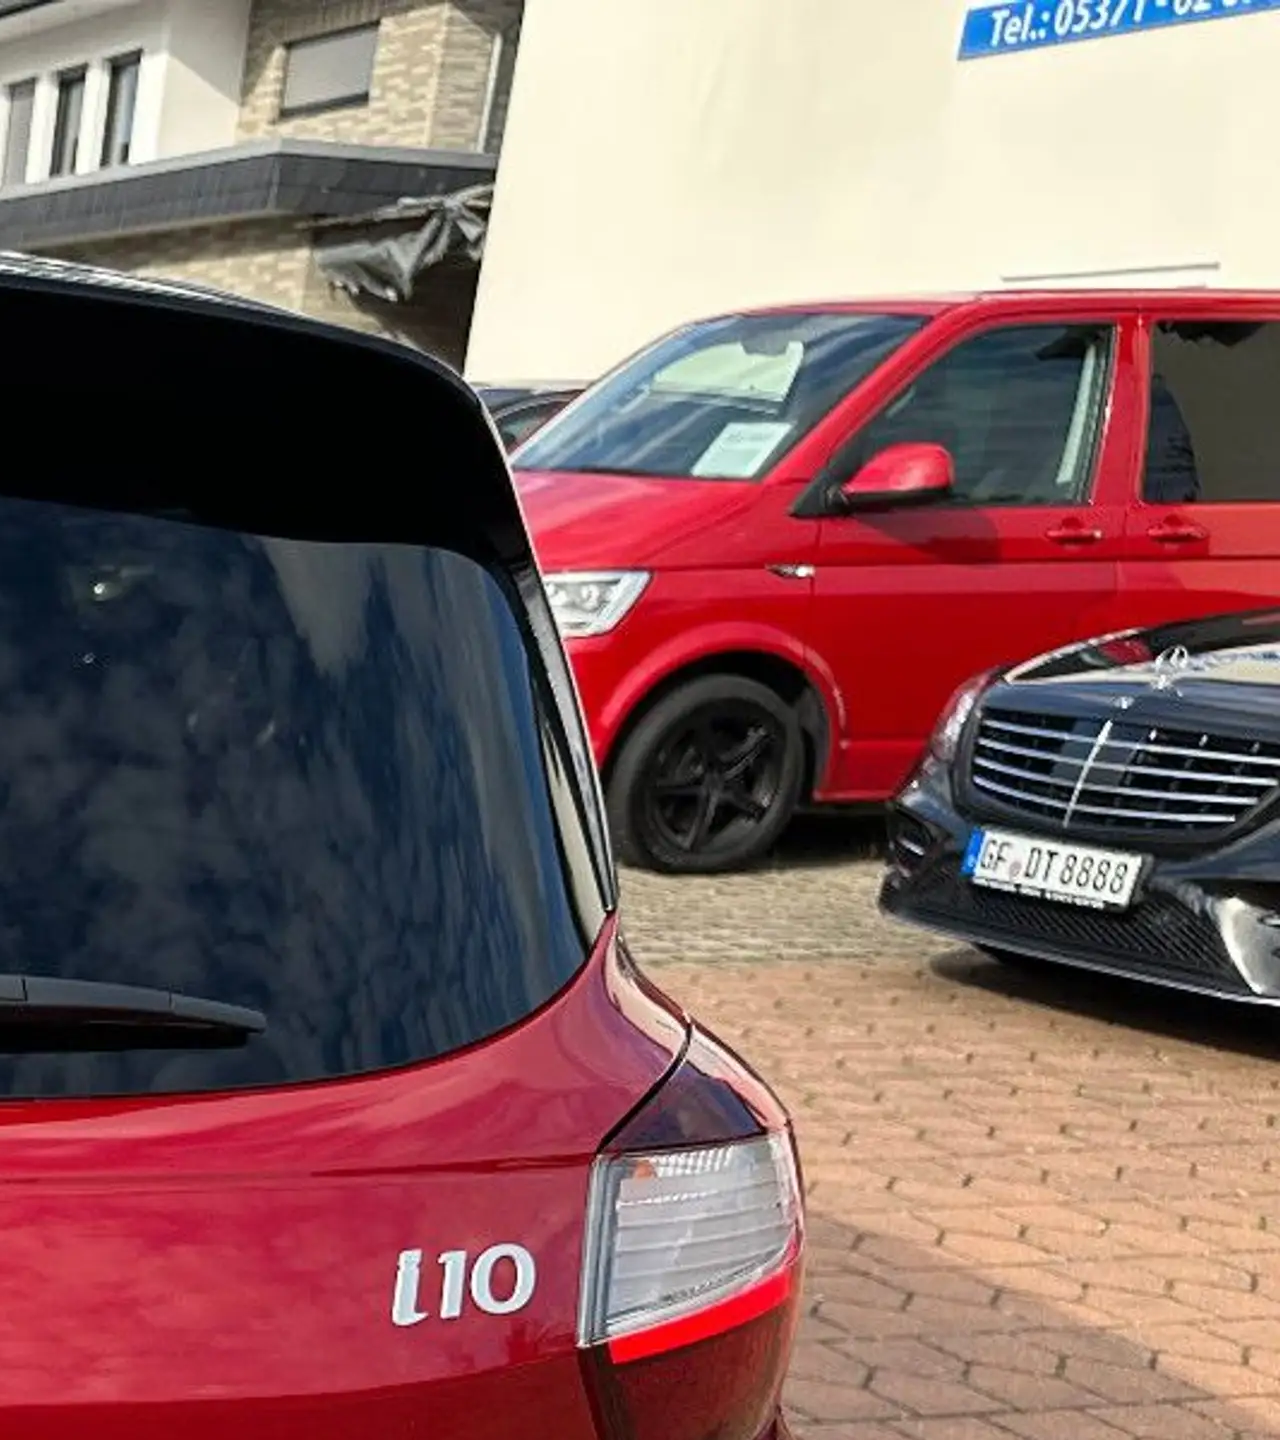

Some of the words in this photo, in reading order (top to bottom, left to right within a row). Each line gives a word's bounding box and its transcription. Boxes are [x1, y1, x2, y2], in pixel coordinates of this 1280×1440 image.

[990, 10, 1047, 47] Tel.:
[981, 839, 1012, 871] GF
[1025, 847, 1059, 882] DT
[1059, 853, 1128, 894] 8888
